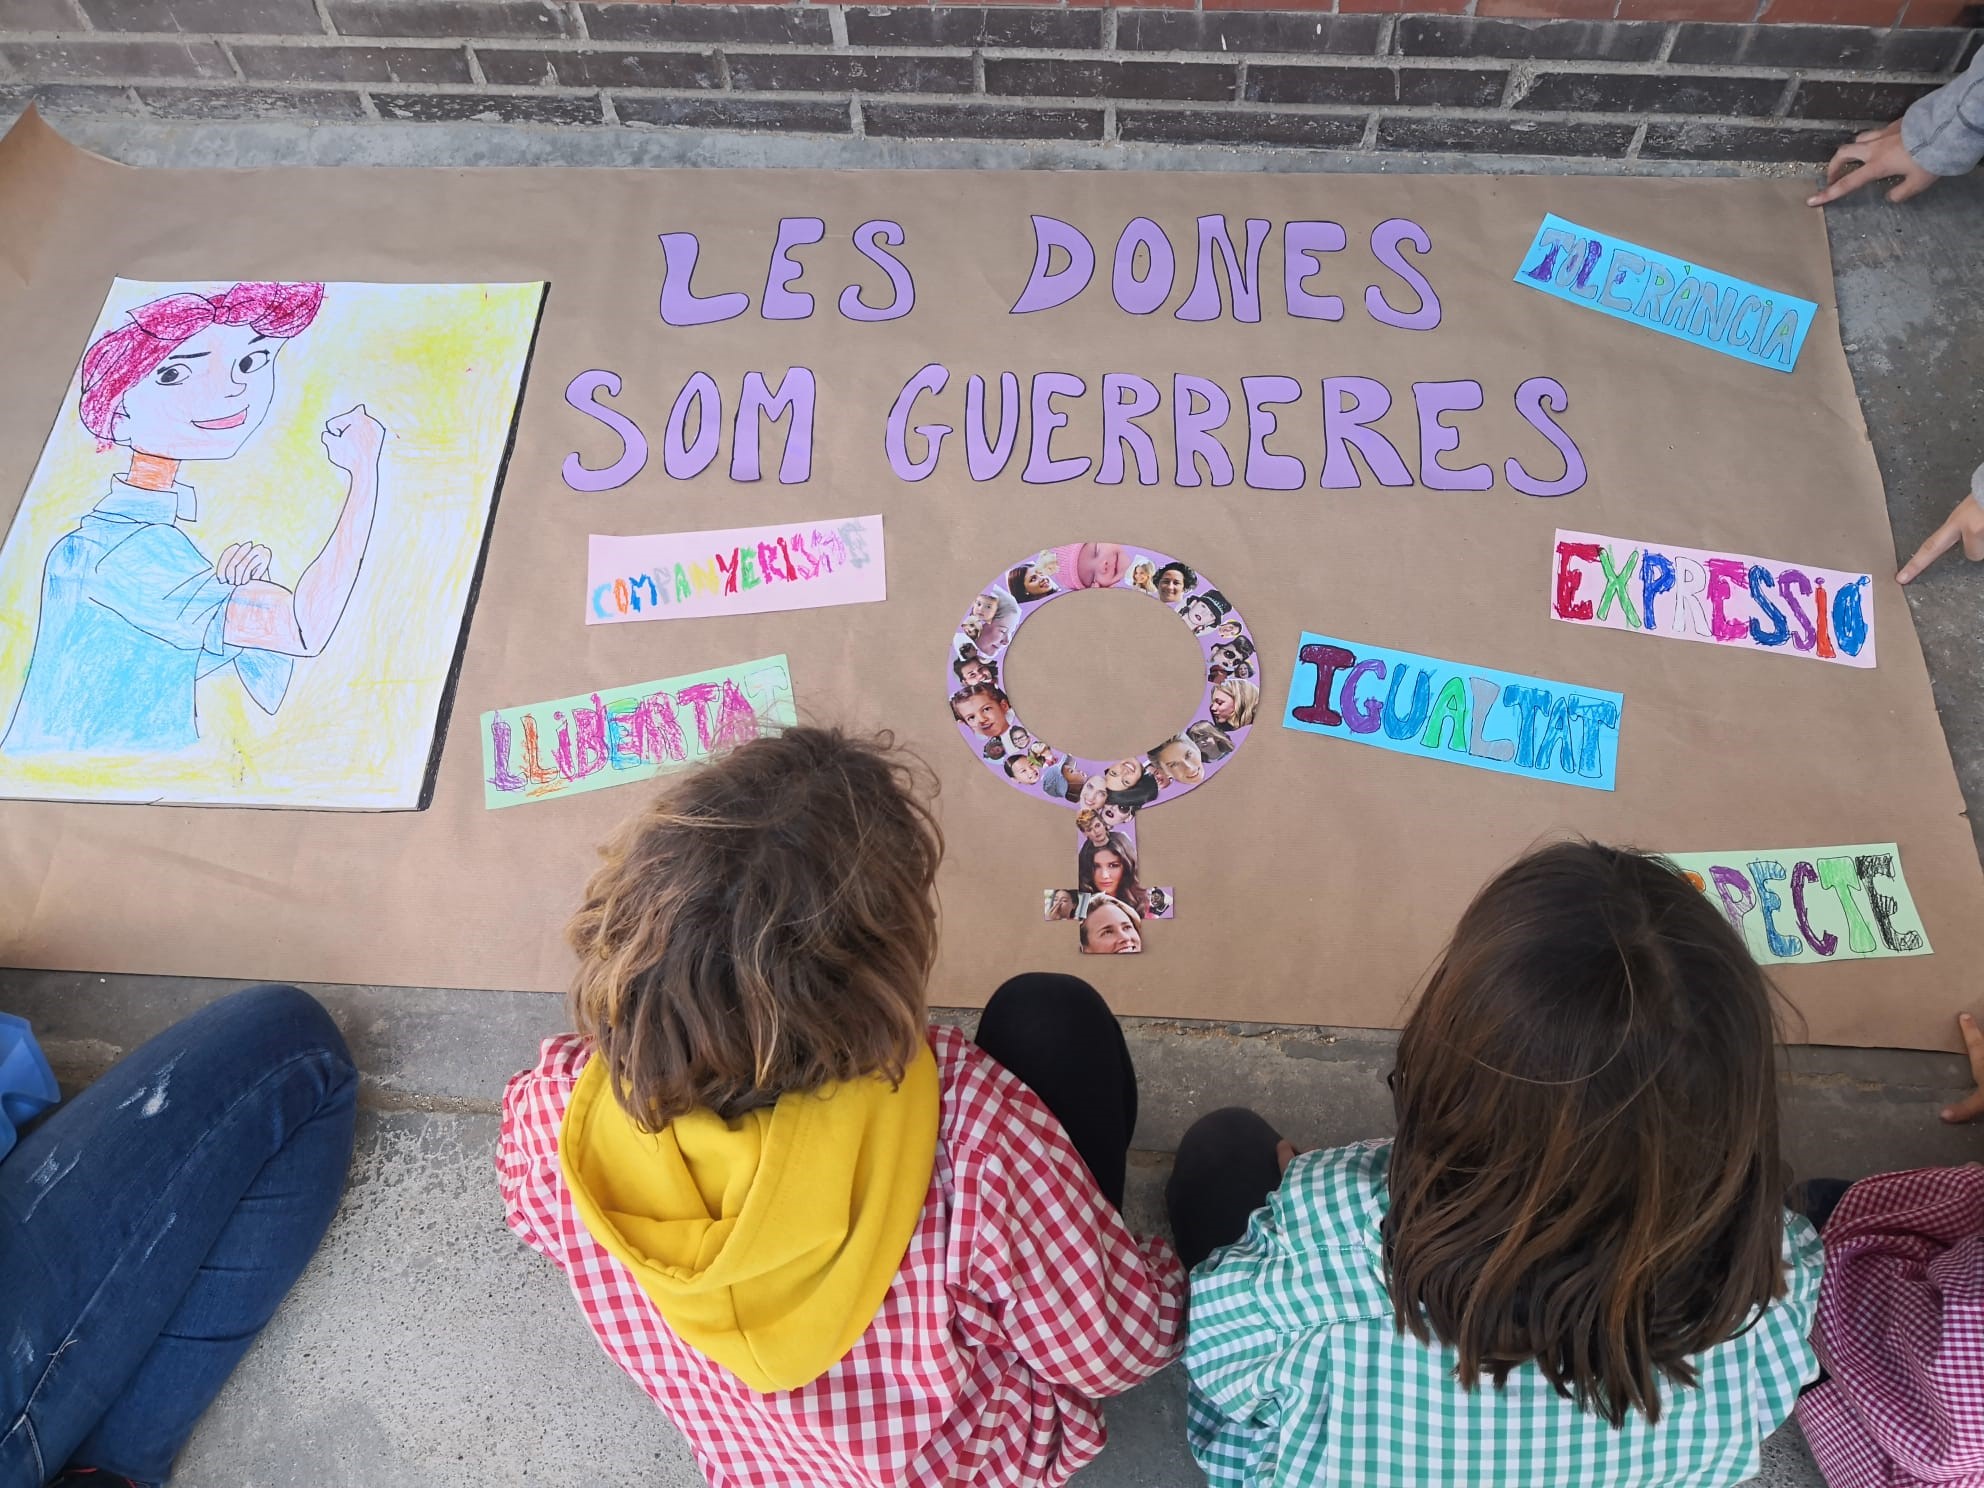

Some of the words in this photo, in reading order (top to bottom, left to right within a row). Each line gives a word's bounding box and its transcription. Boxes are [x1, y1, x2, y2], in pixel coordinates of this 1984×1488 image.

[659, 217, 915, 326] LES
[1009, 214, 1442, 330] DONES
[562, 365, 816, 492] SOM
[885, 363, 1588, 497] GUERRERES
[1292, 643, 1619, 778] IGUALTAT
[1683, 853, 1924, 957] PECTE
